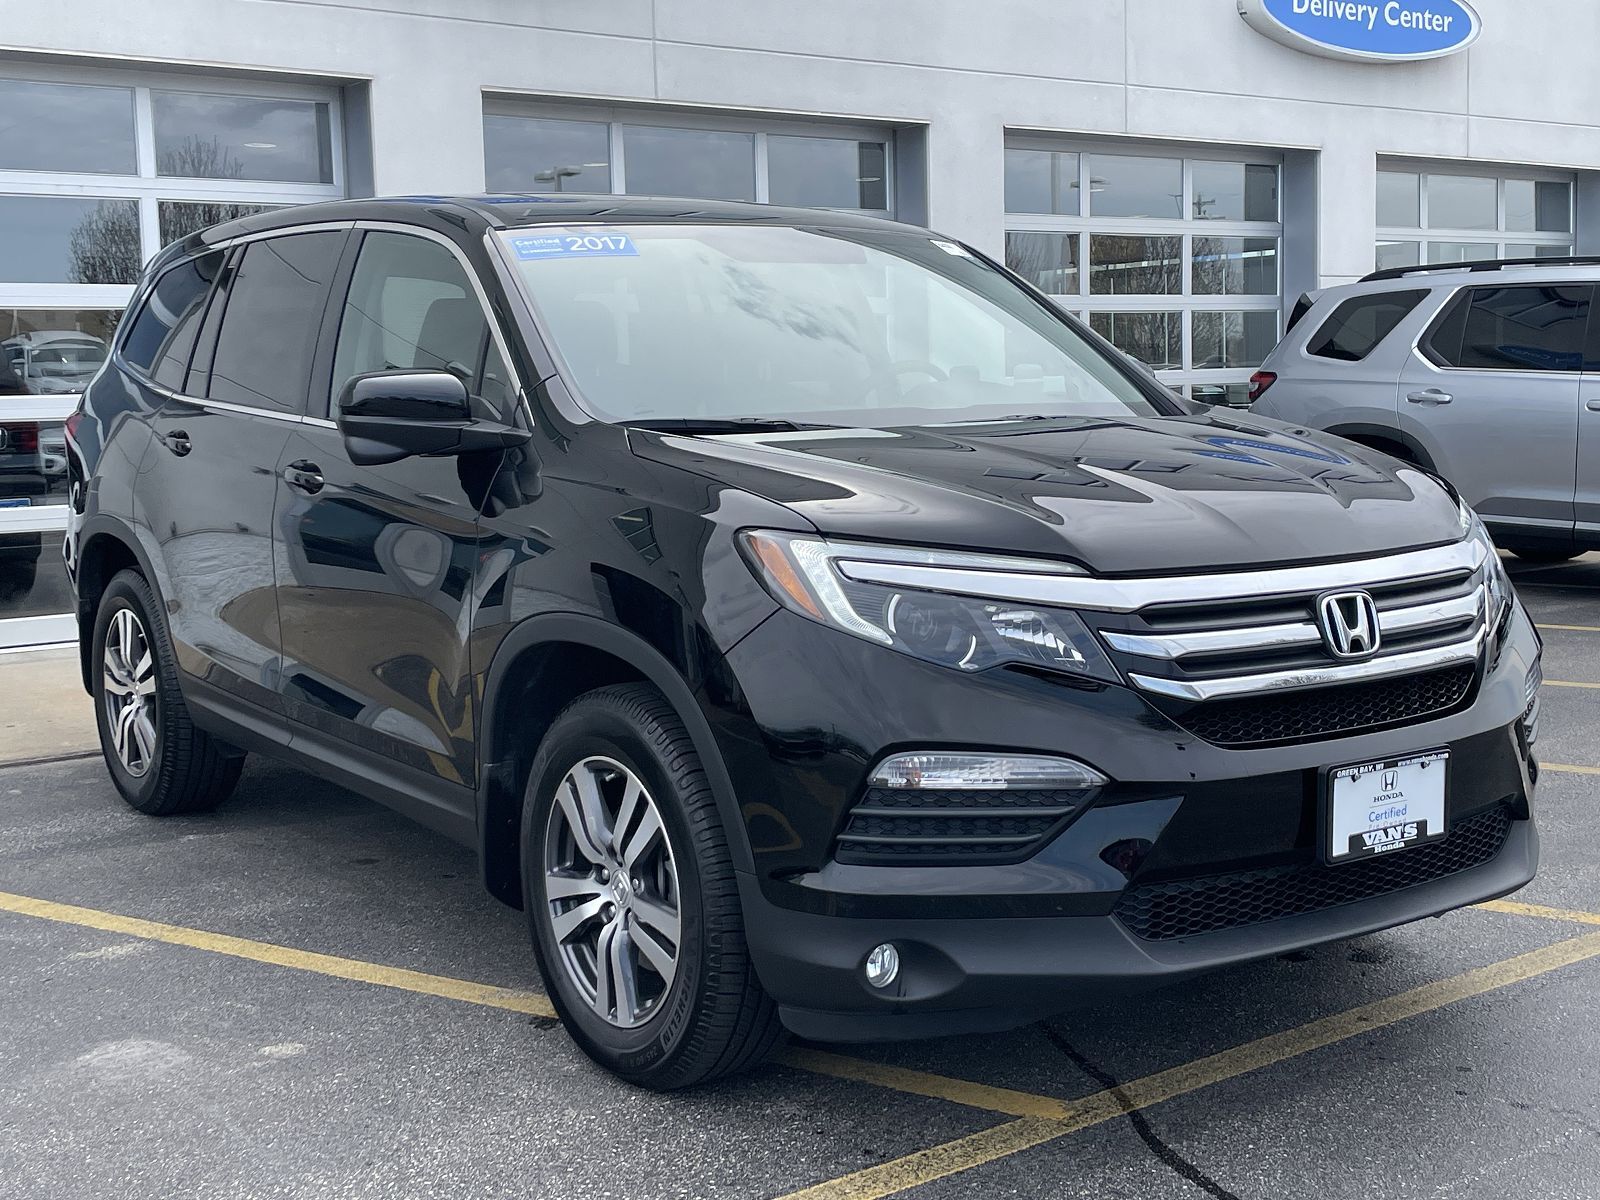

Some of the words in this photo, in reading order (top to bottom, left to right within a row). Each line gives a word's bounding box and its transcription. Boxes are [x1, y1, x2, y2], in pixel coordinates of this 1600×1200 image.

[1292, 0, 1378, 30] Delivery
[1384, 1, 1453, 32] Center
[566, 236, 626, 250] 2017
[1337, 768, 1359, 778] GREEN
[1373, 791, 1404, 803] HONDA
[1368, 804, 1408, 822] Certified
[1362, 823, 1418, 846] VAN'S
[1374, 841, 1405, 854] Honda
[662, 962, 694, 1046] MICHELIN
